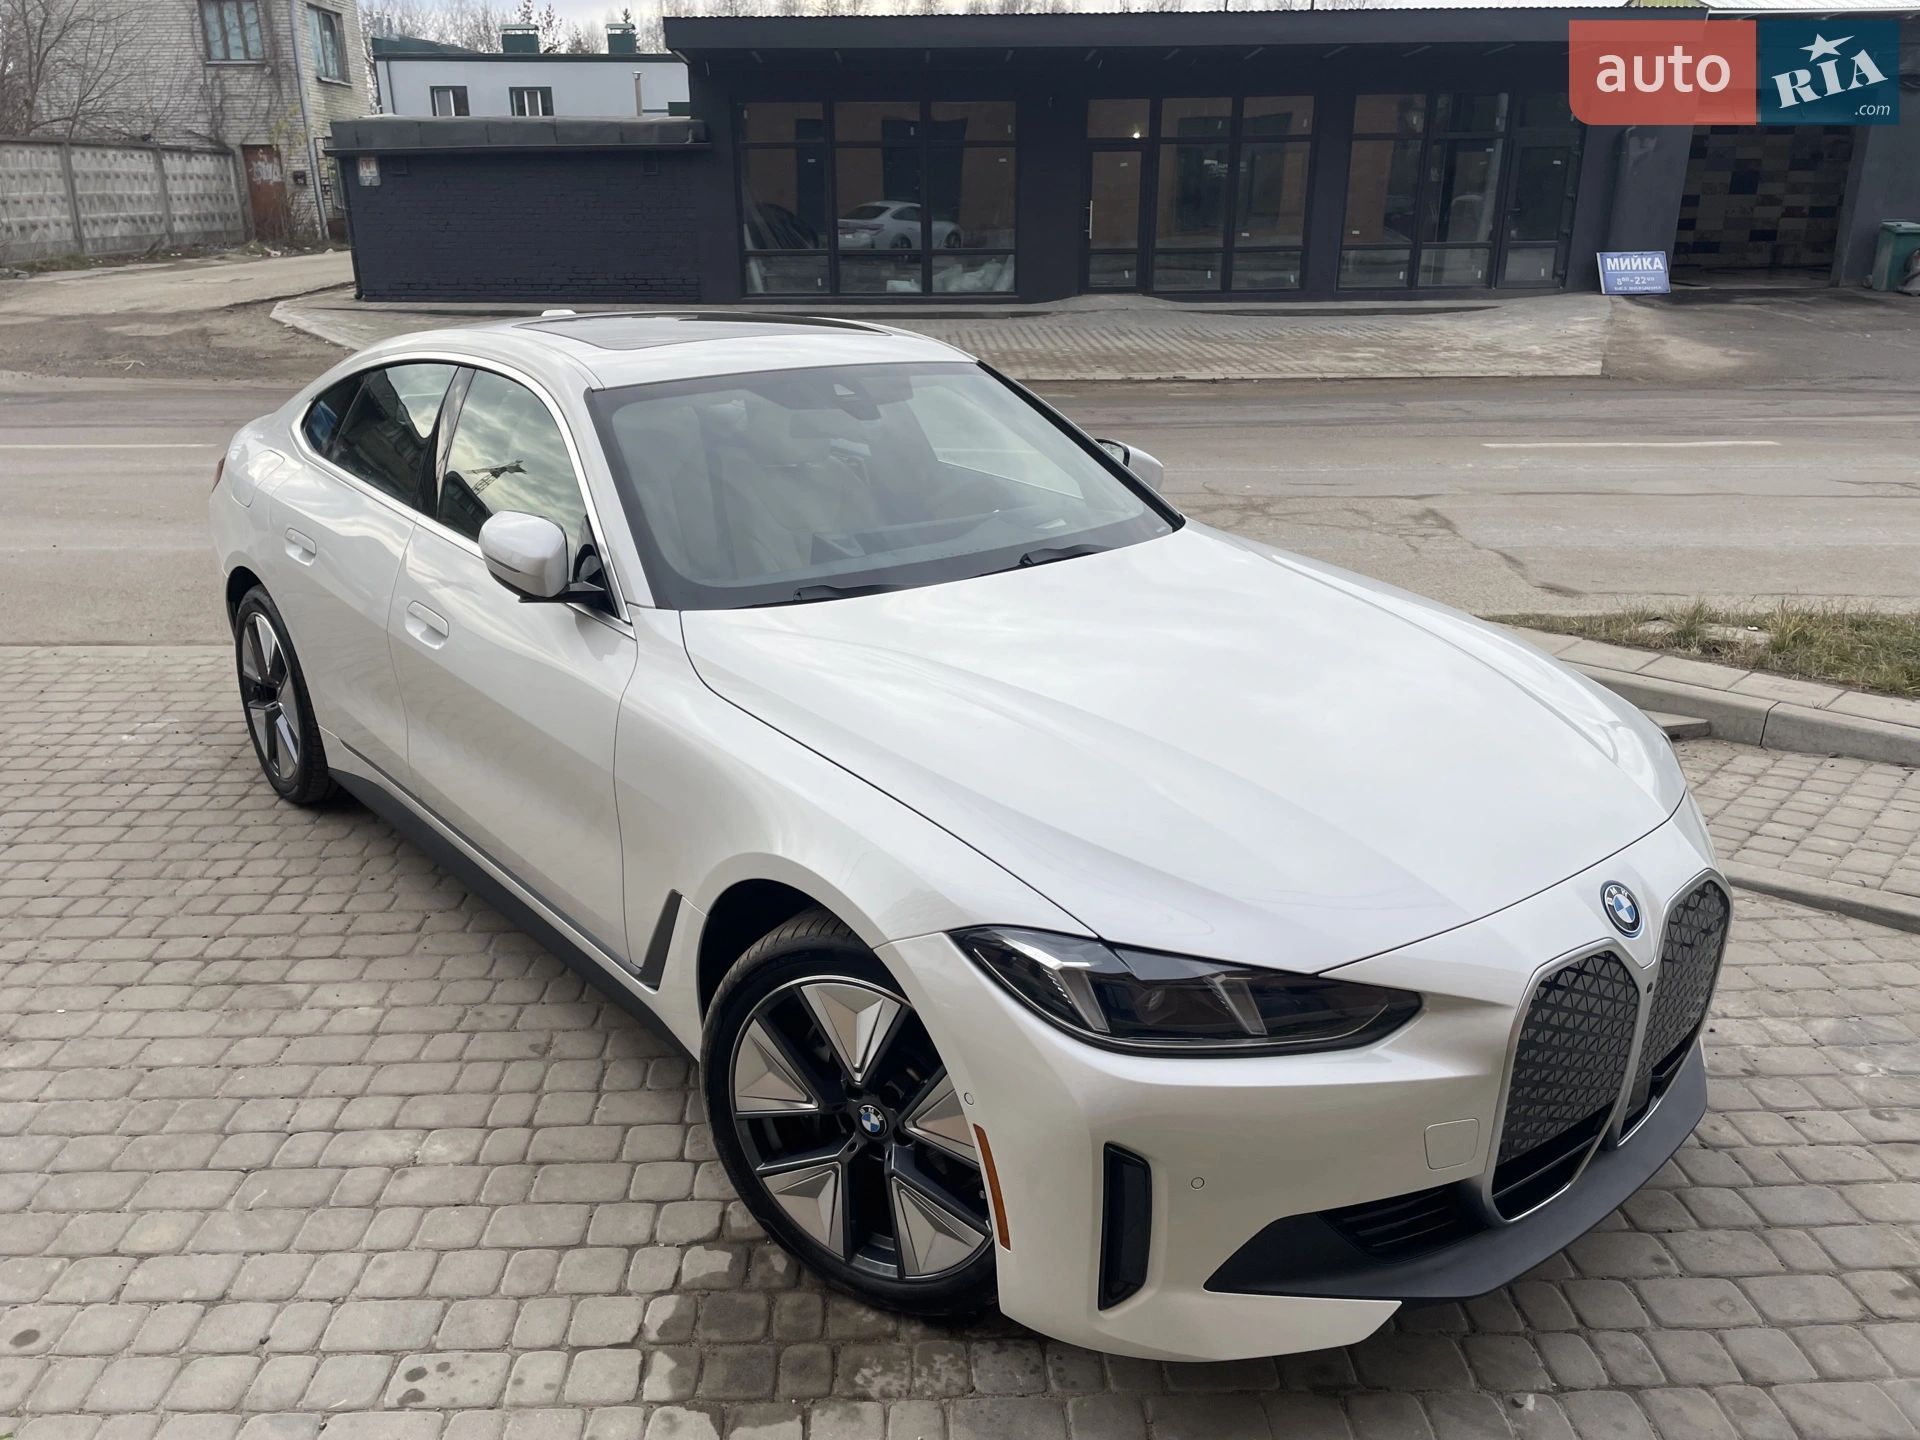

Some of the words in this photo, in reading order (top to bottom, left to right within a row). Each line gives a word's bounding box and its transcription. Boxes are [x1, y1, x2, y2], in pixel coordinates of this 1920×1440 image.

[1606, 254, 1664, 271] МИЙКА
[1606, 886, 1629, 906] BMW
[860, 1107, 884, 1121] BMW
